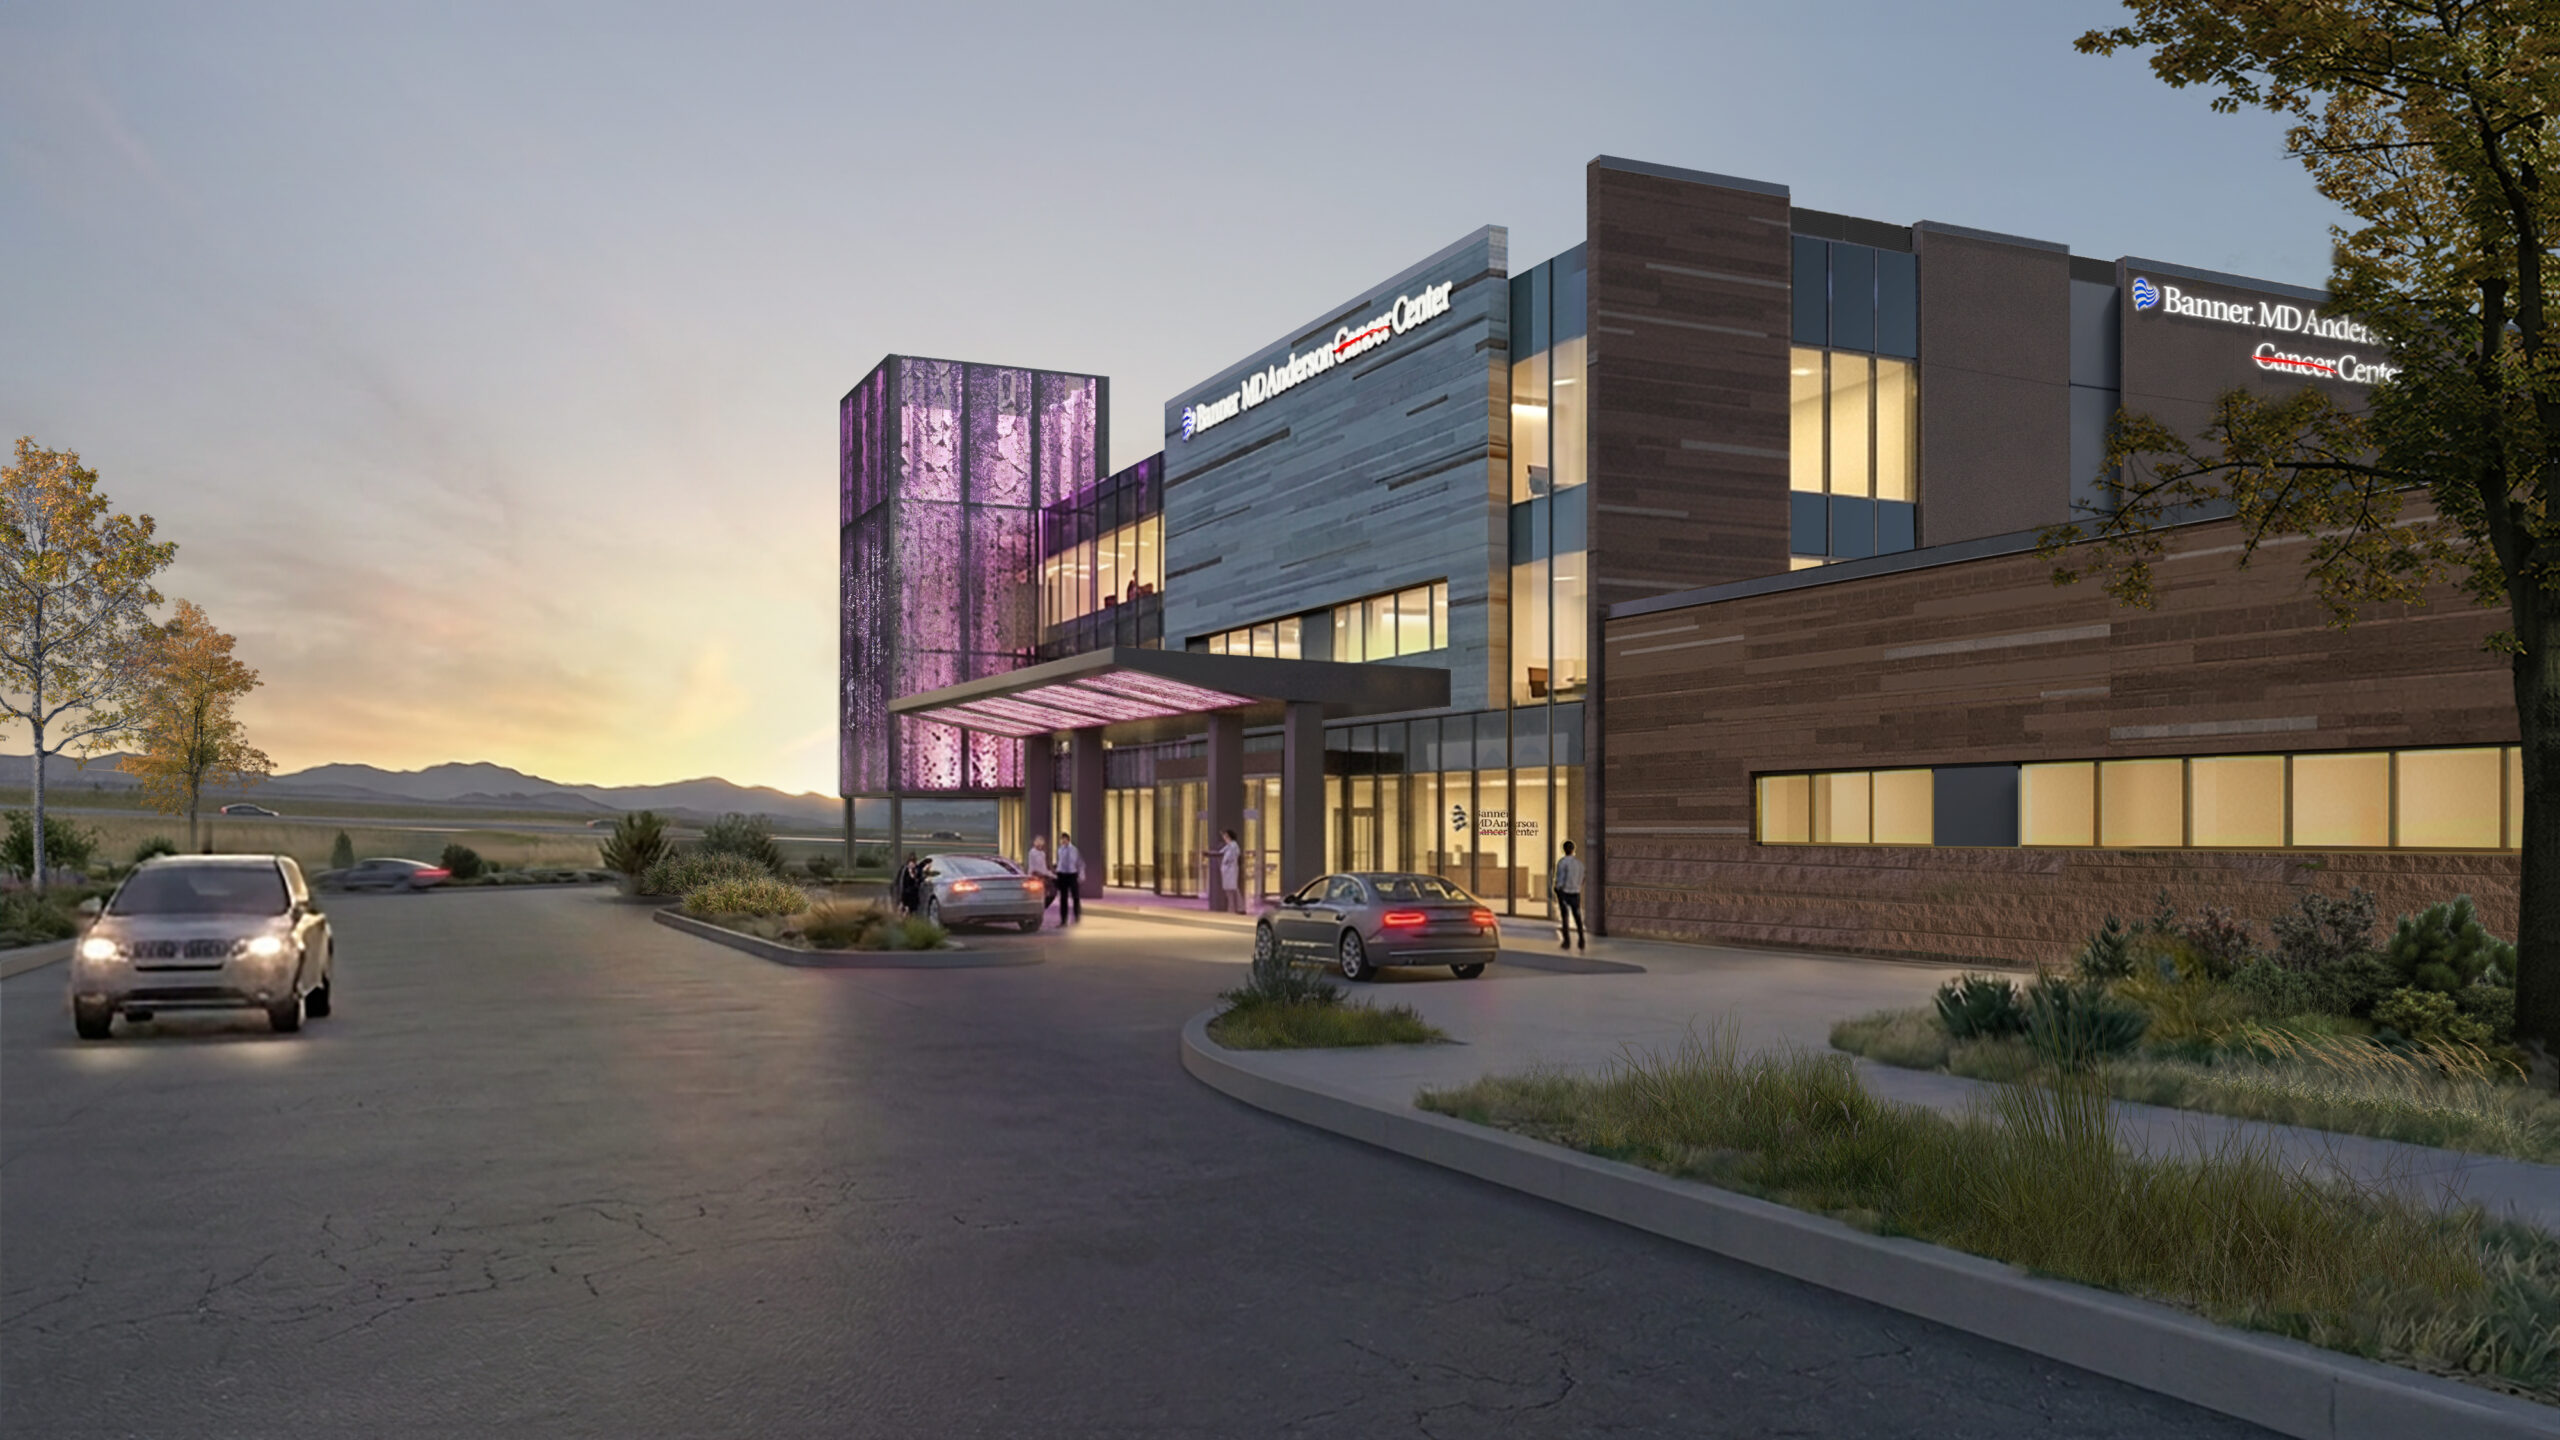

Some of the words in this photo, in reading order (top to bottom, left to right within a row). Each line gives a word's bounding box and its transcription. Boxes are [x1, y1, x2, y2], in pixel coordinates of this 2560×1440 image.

[1196, 392, 1241, 433] Banner
[1333, 311, 1392, 363] Cancer
[1392, 280, 1453, 335] Center
[2252, 342, 2337, 379] Cancer
[1478, 810, 1509, 818] anner
[1478, 827, 1508, 836] ancer
[1515, 828, 1539, 837] enter
